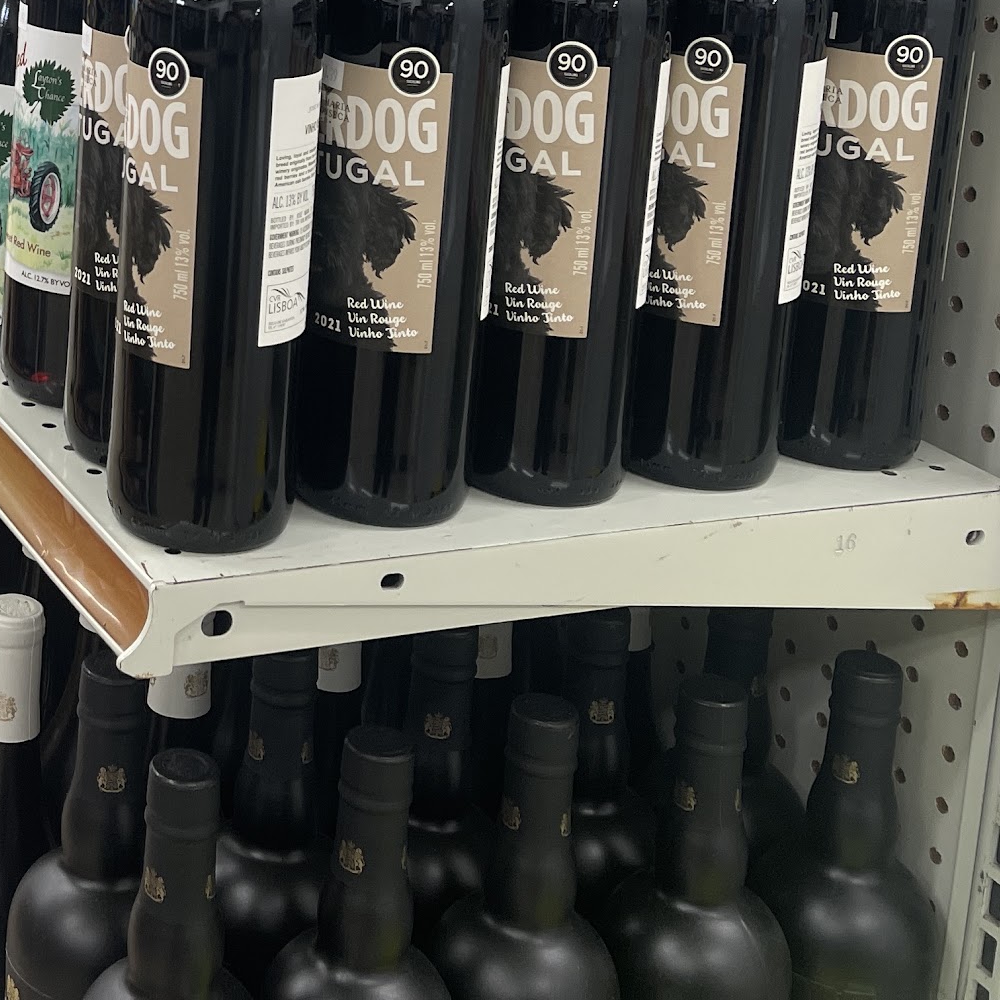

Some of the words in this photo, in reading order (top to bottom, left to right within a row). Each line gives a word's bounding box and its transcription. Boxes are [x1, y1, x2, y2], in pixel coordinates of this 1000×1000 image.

[557, 53, 587, 73] 90
[694, 48, 723, 68] 90
[895, 45, 925, 65] 90
[31, 68, 63, 89] Layton's
[154, 58, 180, 81] 90
[399, 58, 430, 81] 90
[37, 85, 66, 103] Chance
[505, 87, 595, 145] DOG
[505, 146, 582, 176] GAL
[662, 140, 717, 169] AL
[715, 200, 728, 216] vol.
[911, 191, 923, 207] vol.
[581, 209, 594, 226] vol.
[905, 208, 920, 226] 13%
[426, 218, 438, 237] vol.
[710, 218, 725, 237] 13%
[905, 226, 918, 237] ml
[183, 229, 193, 248] vol.
[576, 228, 590, 247] 13%
[710, 236, 722, 247] ml
[902, 236, 916, 254] 750
[26, 241, 52, 258] Wine
[420, 238, 435, 258] 13%
[577, 246, 588, 258] ml
[706, 247, 721, 266] 750
[94, 251, 110, 265] Red
[177, 251, 190, 270] 13%
[420, 257, 432, 269] ml
[573, 258, 588, 276] 750
[74, 265, 92, 286] 2021
[662, 270, 694, 283] Wine
[833, 263, 857, 275] Red
[857, 263, 891, 275] Wine
[94, 277, 118, 293] Vinh
[417, 269, 431, 290] 750
[504, 281, 527, 295] Red
[526, 282, 560, 296] Wine
[802, 278, 828, 296] 021
[833, 276, 856, 288] Vin
[856, 277, 893, 290] Rouge
[173, 282, 187, 301] 750
[661, 284, 697, 298] Rouge
[833, 289, 871, 302] Vinho
[871, 289, 902, 302] Tinto
[123, 299, 136, 315] Red
[136, 302, 162, 318] Wine
[347, 296, 369, 310] Red
[369, 297, 405, 311] Wine
[505, 295, 526, 309] Vin
[527, 297, 563, 312] Rouge
[676, 297, 707, 311] Tinto
[123, 315, 136, 330] Vin
[136, 318, 166, 335] Rouge
[314, 311, 343, 334] 2021
[347, 311, 370, 325] Vin
[370, 312, 407, 328] Rouge
[505, 310, 541, 324] Vinho
[541, 311, 575, 325] Tinto
[123, 331, 147, 347] Vinho
[147, 333, 177, 350] Tinto
[347, 325, 385, 340] Vinho
[385, 326, 419, 341] Tinto
[834, 532, 858, 554] 16
